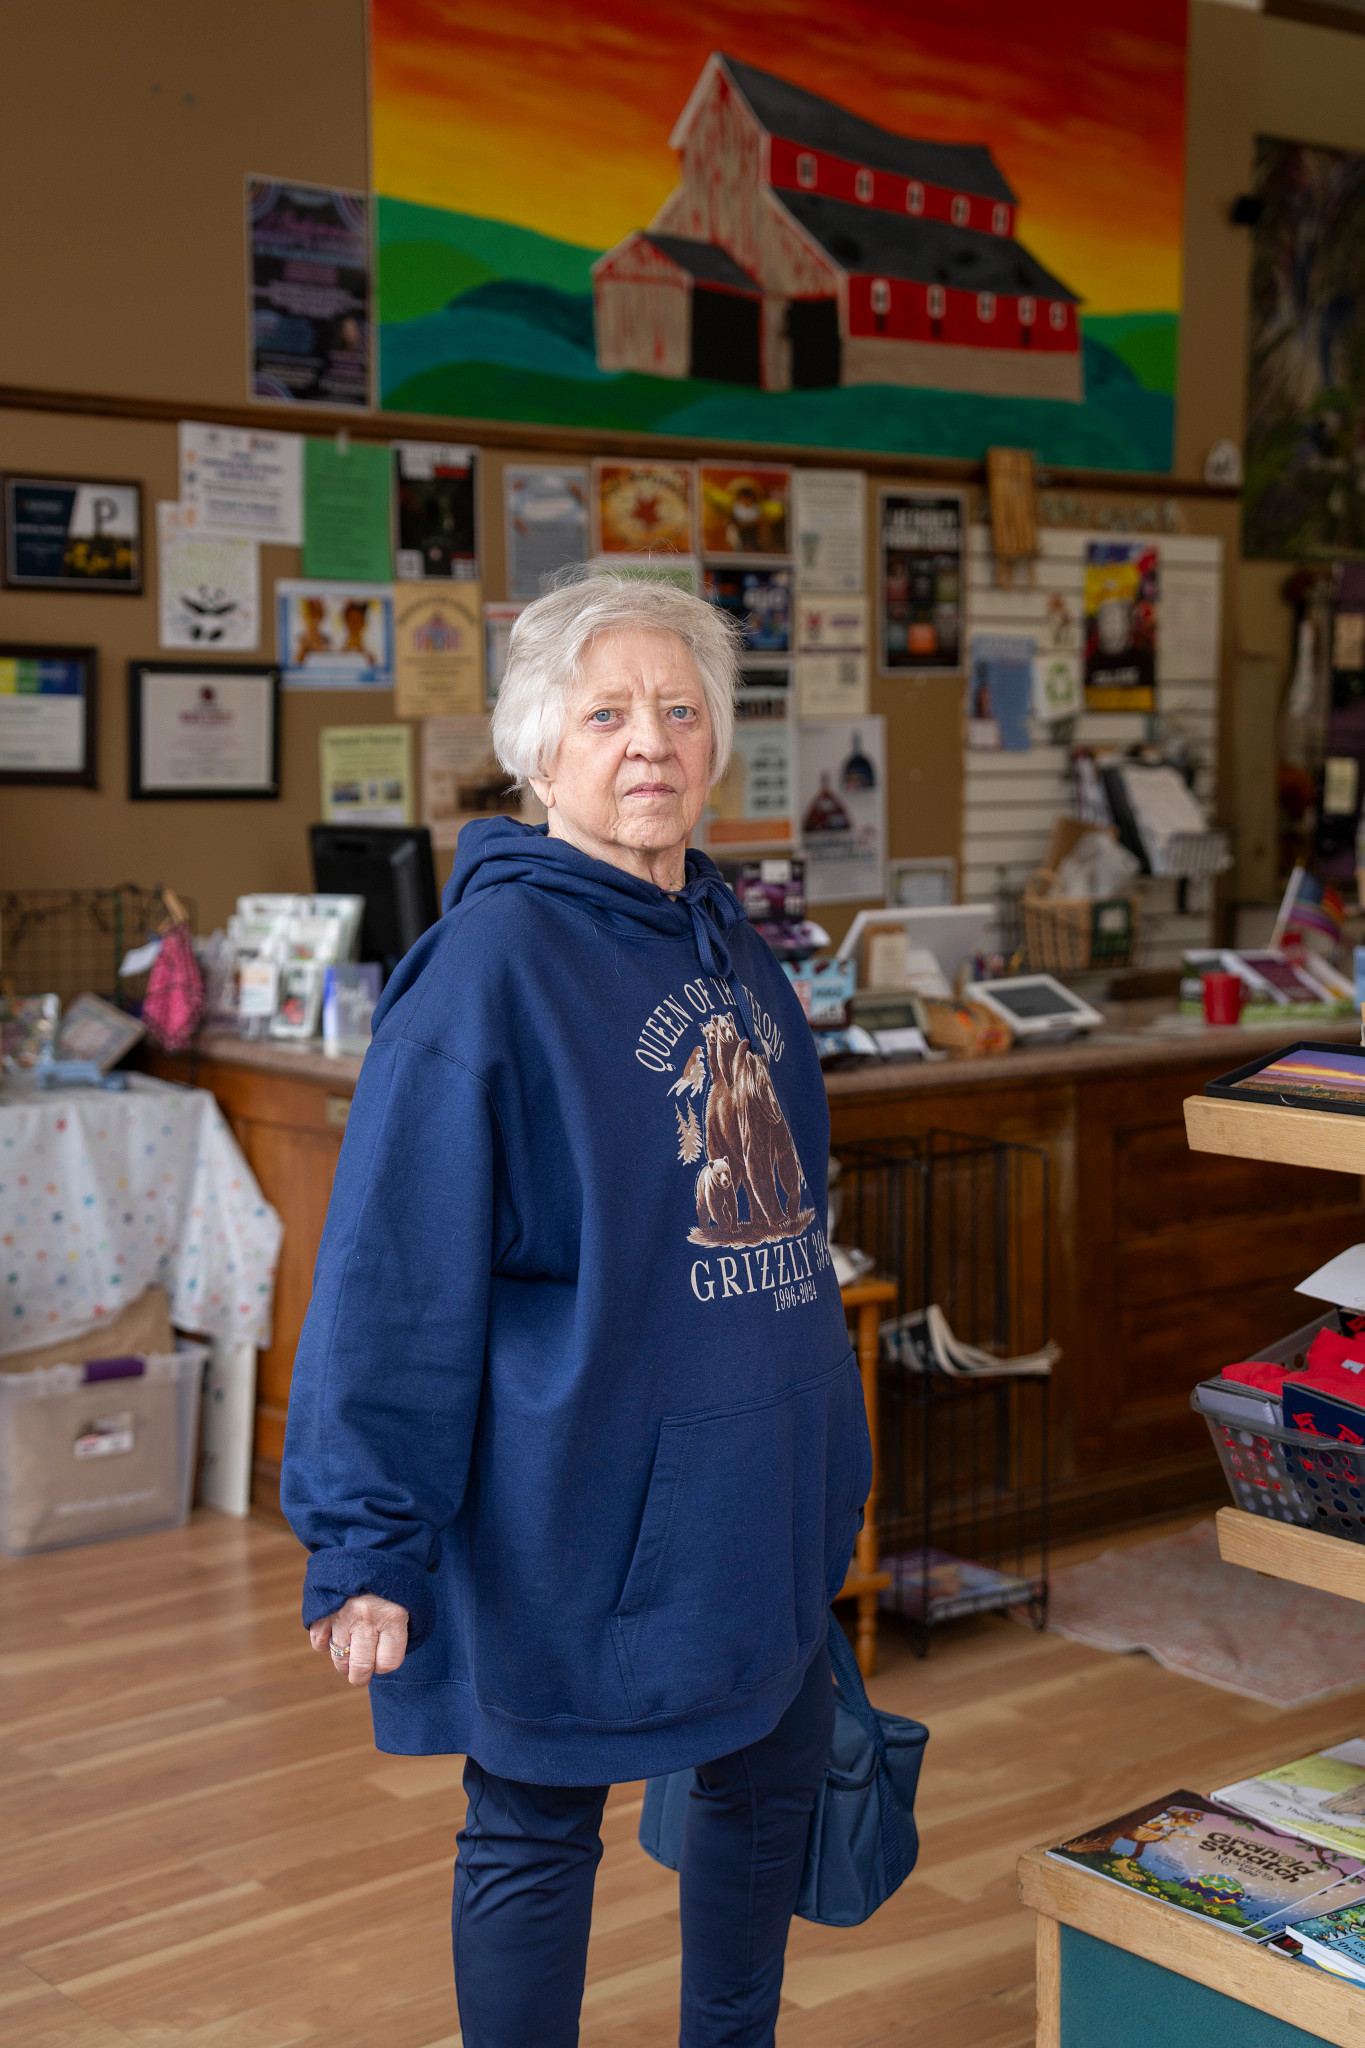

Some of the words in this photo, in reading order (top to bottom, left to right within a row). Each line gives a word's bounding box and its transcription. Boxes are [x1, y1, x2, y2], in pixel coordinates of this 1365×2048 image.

[635, 994, 694, 1072] QUEEN
[683, 978, 715, 1014] OF
[709, 977, 737, 1005] TH
[690, 1237, 812, 1302] GRIZZLY
[773, 1280, 817, 1312] 1996-2024
[1198, 1840, 1300, 1883] Squatch
